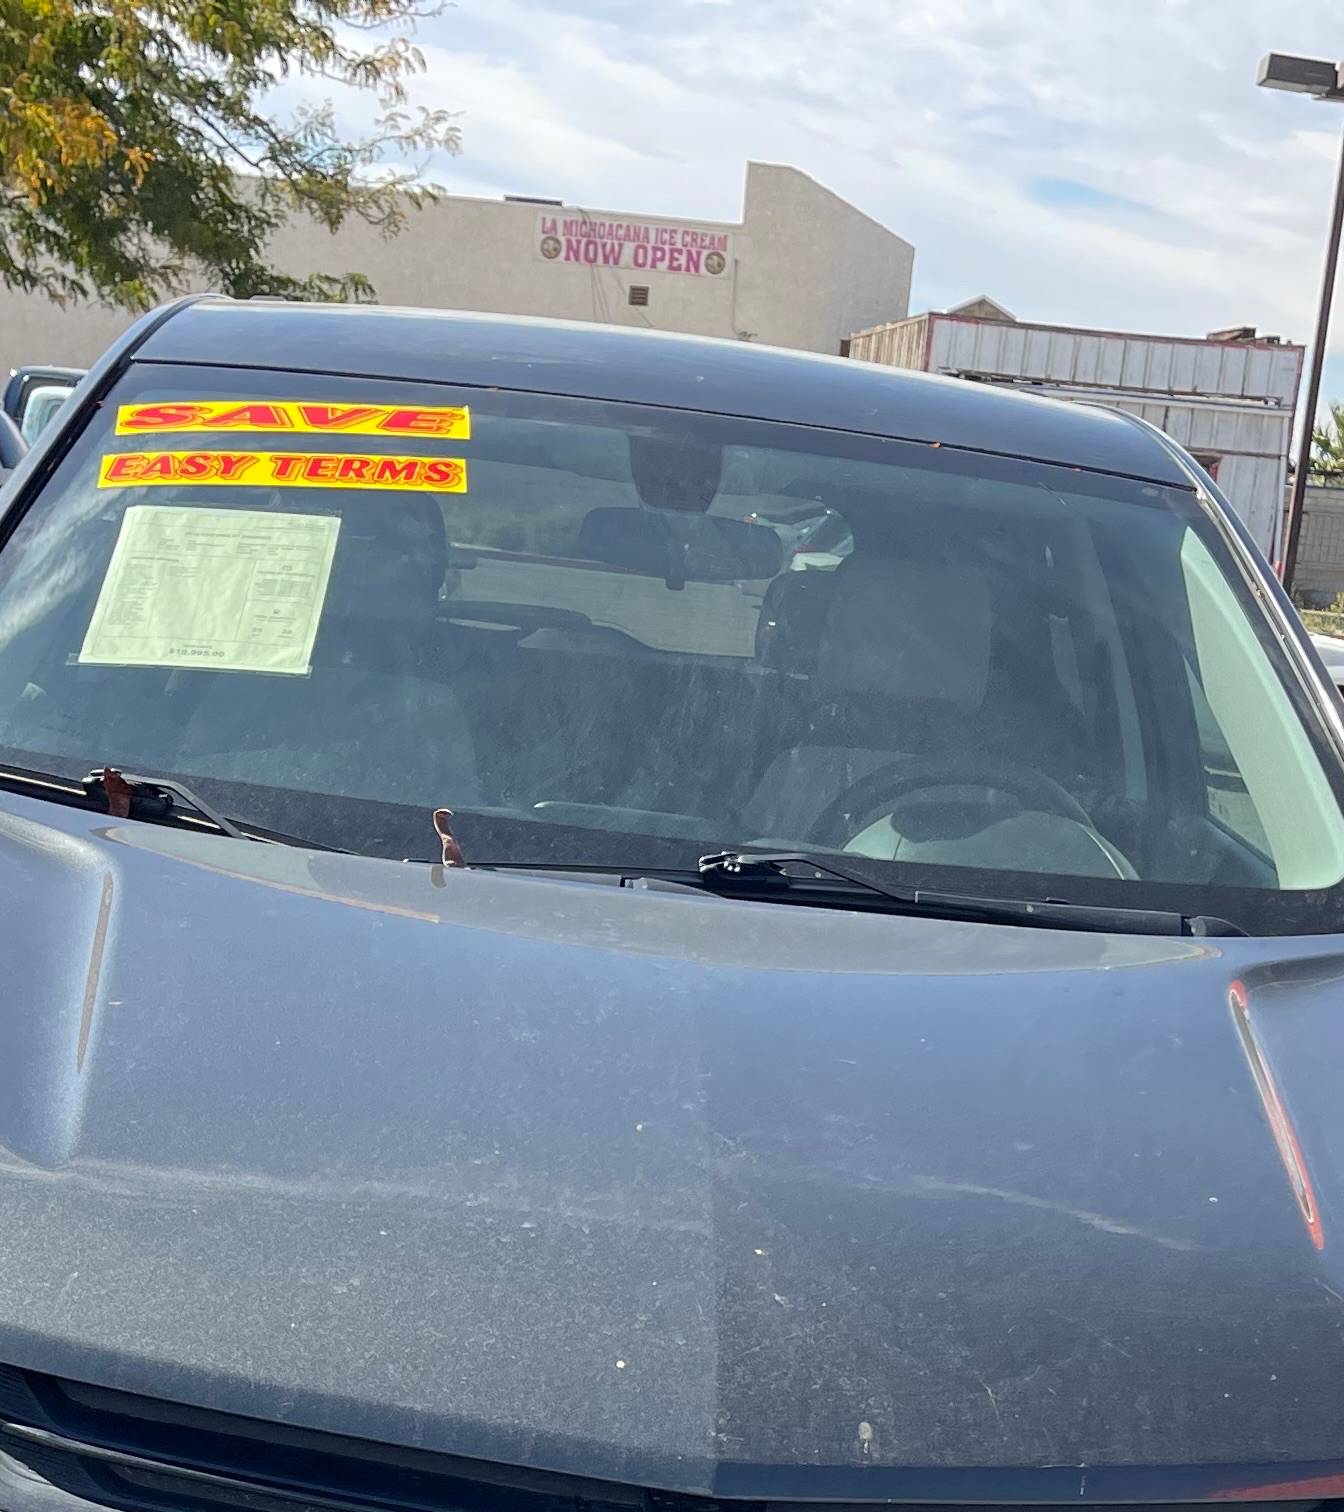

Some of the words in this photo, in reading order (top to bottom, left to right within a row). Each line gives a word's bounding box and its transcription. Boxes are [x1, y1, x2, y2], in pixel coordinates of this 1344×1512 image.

[541, 217, 558, 235] LA
[654, 228, 677, 246] ICE
[681, 229, 729, 252] CREAM
[563, 238, 625, 267] NOW
[632, 243, 704, 274] OPEN
[121, 404, 466, 434] SAVE
[105, 453, 260, 483] EASY
[269, 455, 463, 488] TERMS
